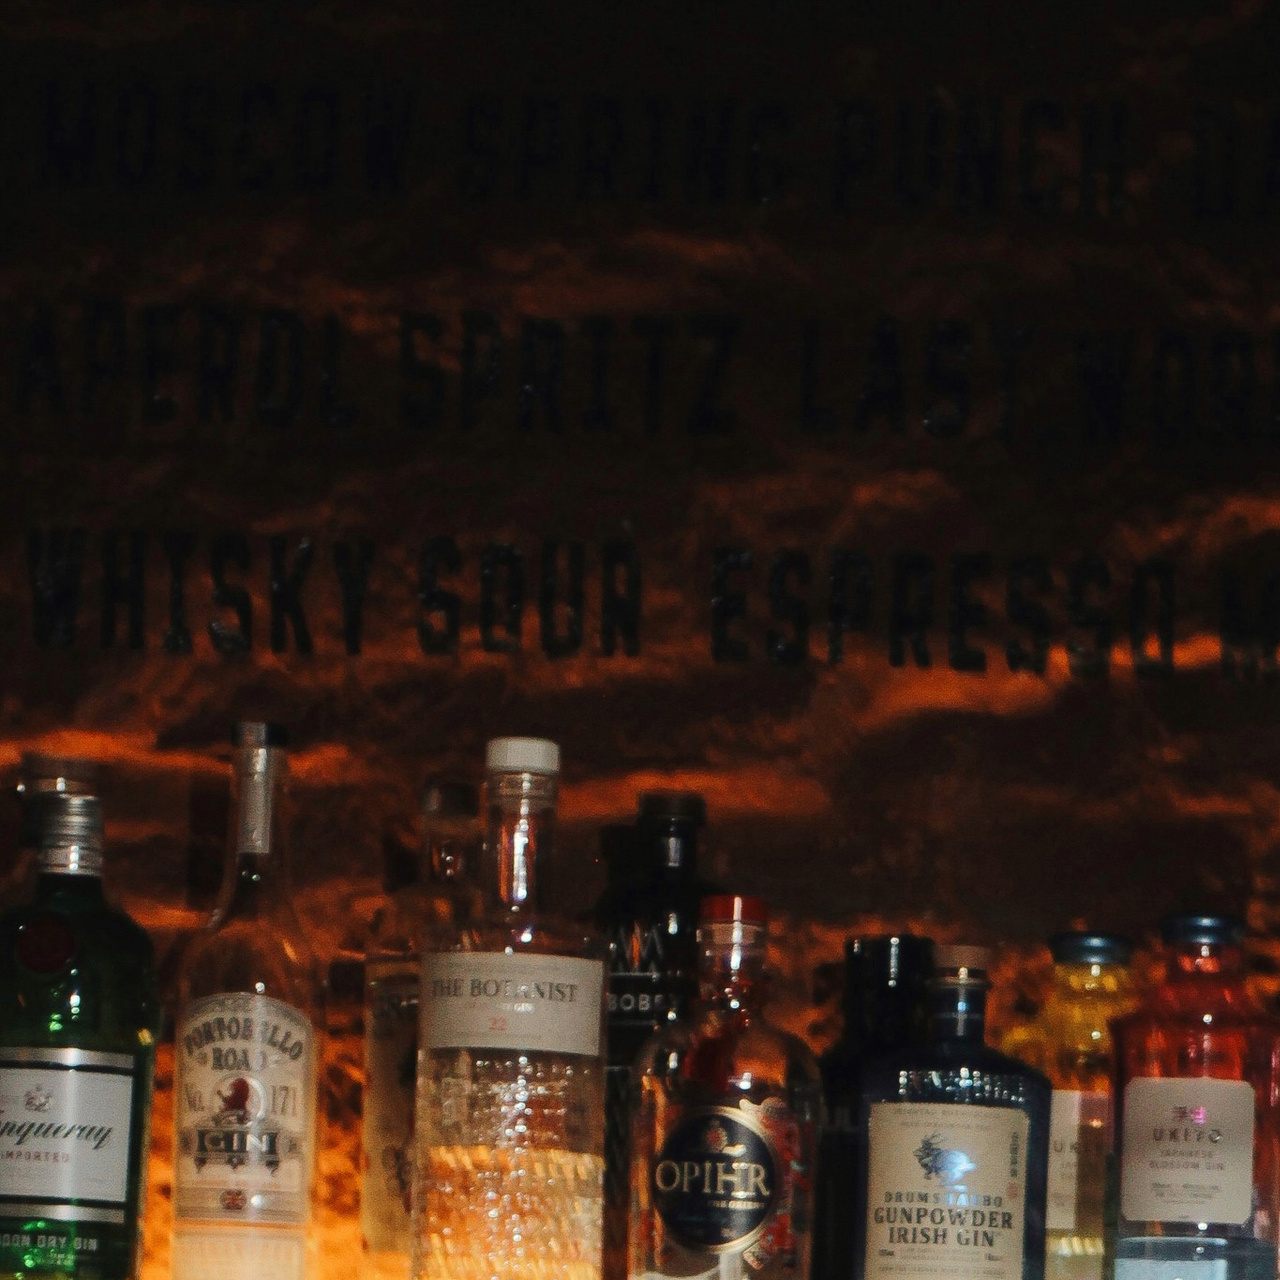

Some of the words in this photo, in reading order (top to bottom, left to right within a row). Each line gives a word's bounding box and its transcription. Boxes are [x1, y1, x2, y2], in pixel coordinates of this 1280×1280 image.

[42, 80, 415, 194] MOSCOW
[462, 92, 790, 203] SPRING
[832, 97, 1130, 218] PUNCH
[14, 297, 358, 430] APEROL
[402, 309, 743, 436] SPRITZ
[802, 315, 1028, 444] LAST
[26, 526, 376, 655] WHISKY
[417, 533, 643, 659] SOUR
[710, 544, 1177, 679] ESPRESSO
[431, 977, 463, 997] THE
[209, 1130, 271, 1152] GIN
[655, 1159, 770, 1198] OPIHR
[884, 1190, 1004, 1208] DRUMSABO
[873, 1207, 1013, 1230] GUNPOWDER
[888, 1226, 947, 1245] IRISH
[956, 1229, 996, 1247] GIN
